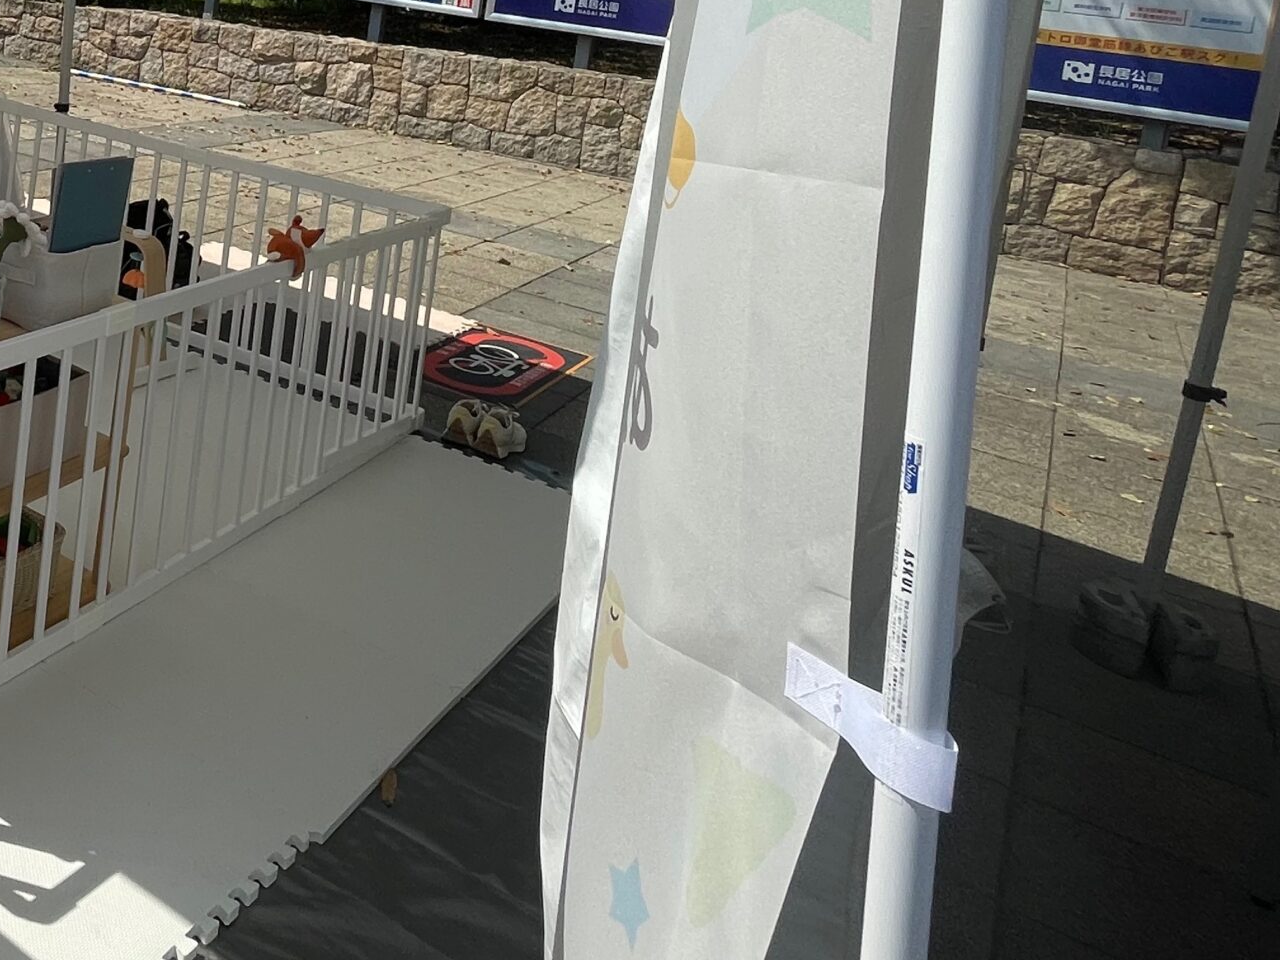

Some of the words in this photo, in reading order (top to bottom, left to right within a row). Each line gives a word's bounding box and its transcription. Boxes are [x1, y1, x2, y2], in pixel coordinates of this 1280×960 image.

[1097, 77, 1129, 89] NAGAI
[1131, 82, 1161, 93] PARK
[1098, 64, 1165, 85] 長居公園
[901, 548, 915, 594] ASKUL
